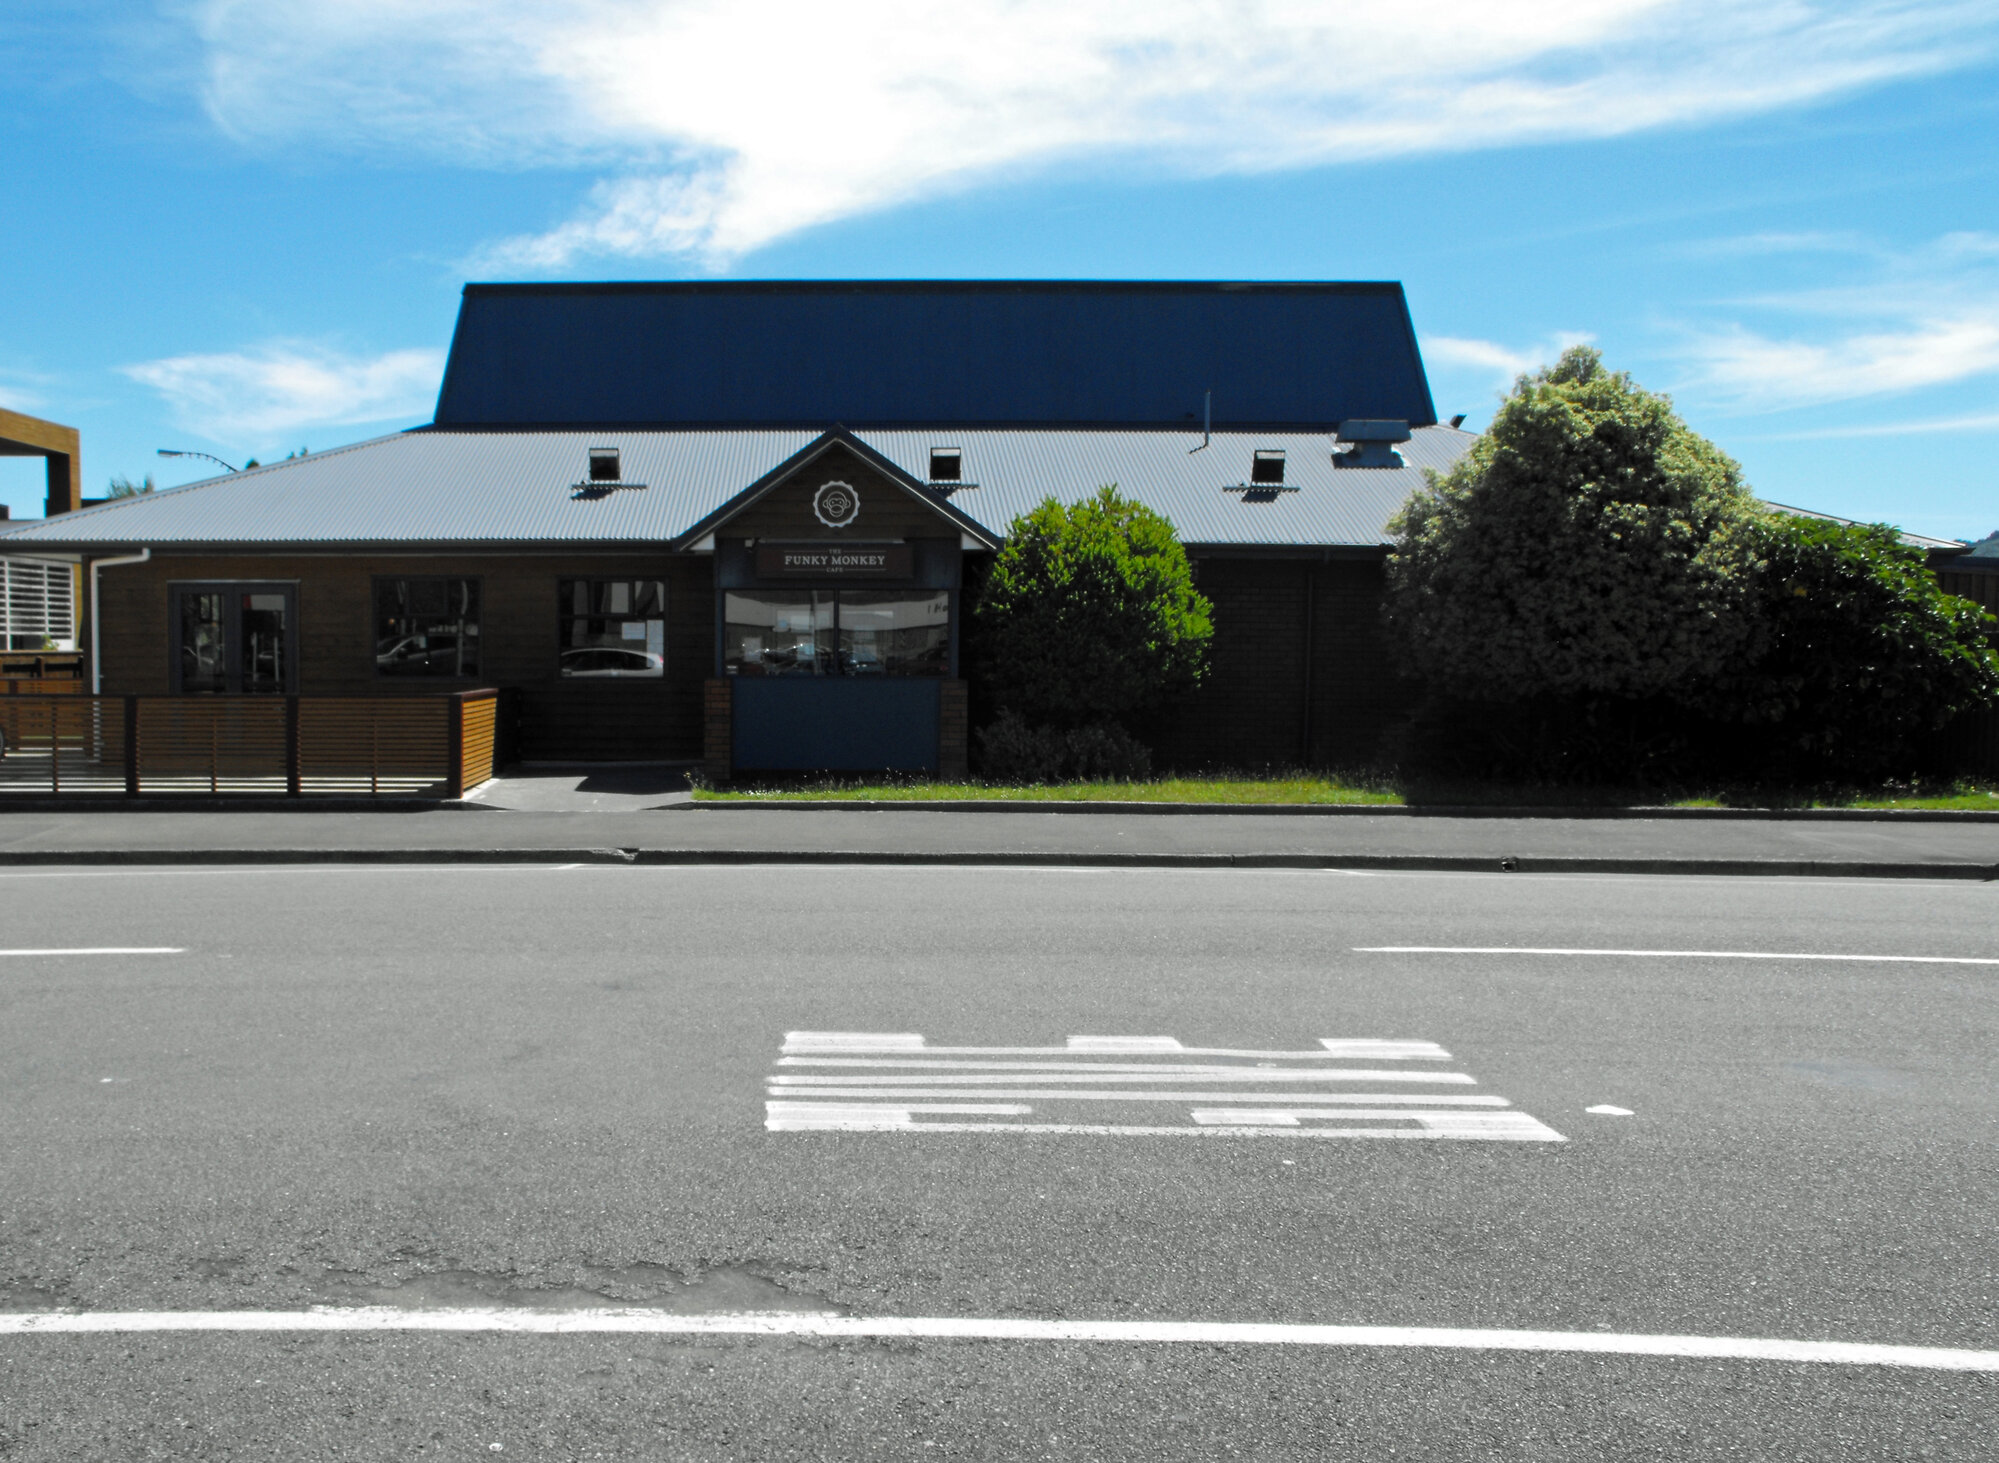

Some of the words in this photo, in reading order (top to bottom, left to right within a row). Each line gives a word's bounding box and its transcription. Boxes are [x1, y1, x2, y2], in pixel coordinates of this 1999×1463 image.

[784, 555, 828, 565] FUNKY
[831, 555, 885, 565] MONKEY
[765, 1031, 1567, 1142] GIVE
